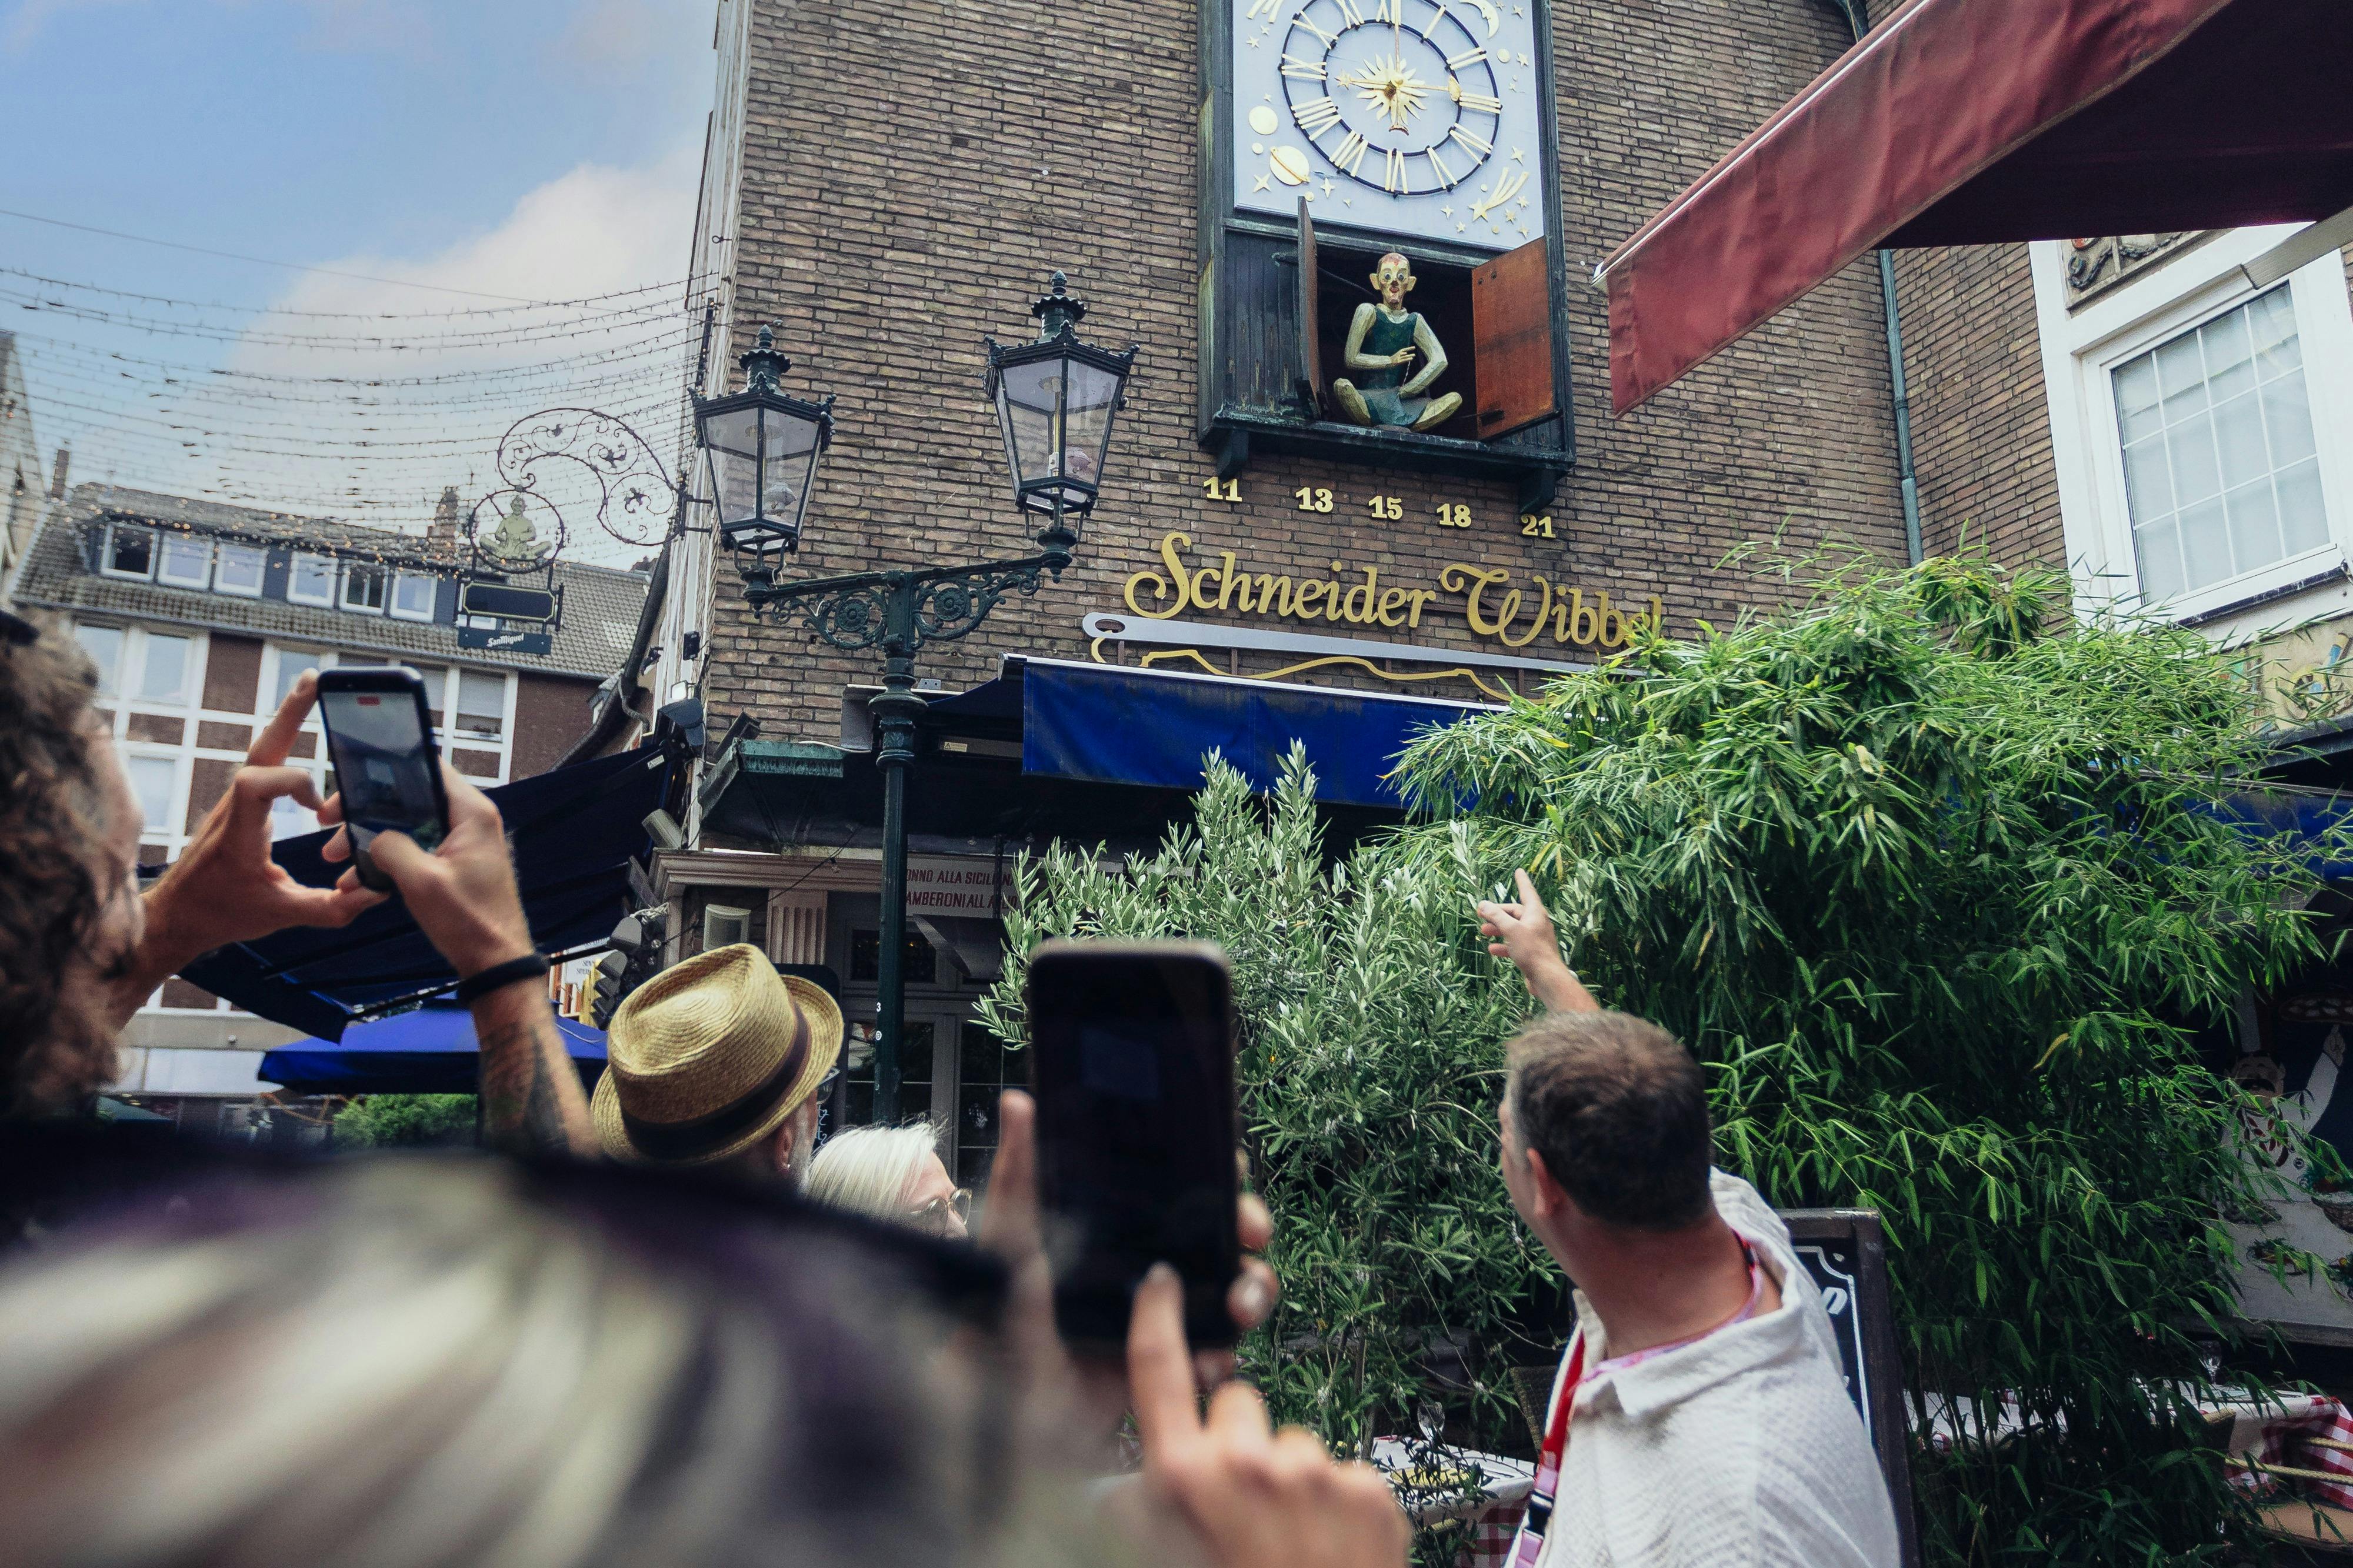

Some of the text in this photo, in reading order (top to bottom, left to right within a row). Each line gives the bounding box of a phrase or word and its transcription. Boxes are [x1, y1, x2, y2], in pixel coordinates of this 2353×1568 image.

[1292, 10, 1339, 49] X
[1204, 476, 1557, 538] 11 13 15 18 21
[1124, 532, 1662, 648] Schneider Wibbel
[906, 869, 934, 882] ONNO
[936, 870, 962, 884] ALLA
[906, 891, 966, 908] AMBERONI
[876, 1002, 881, 1012] 3
